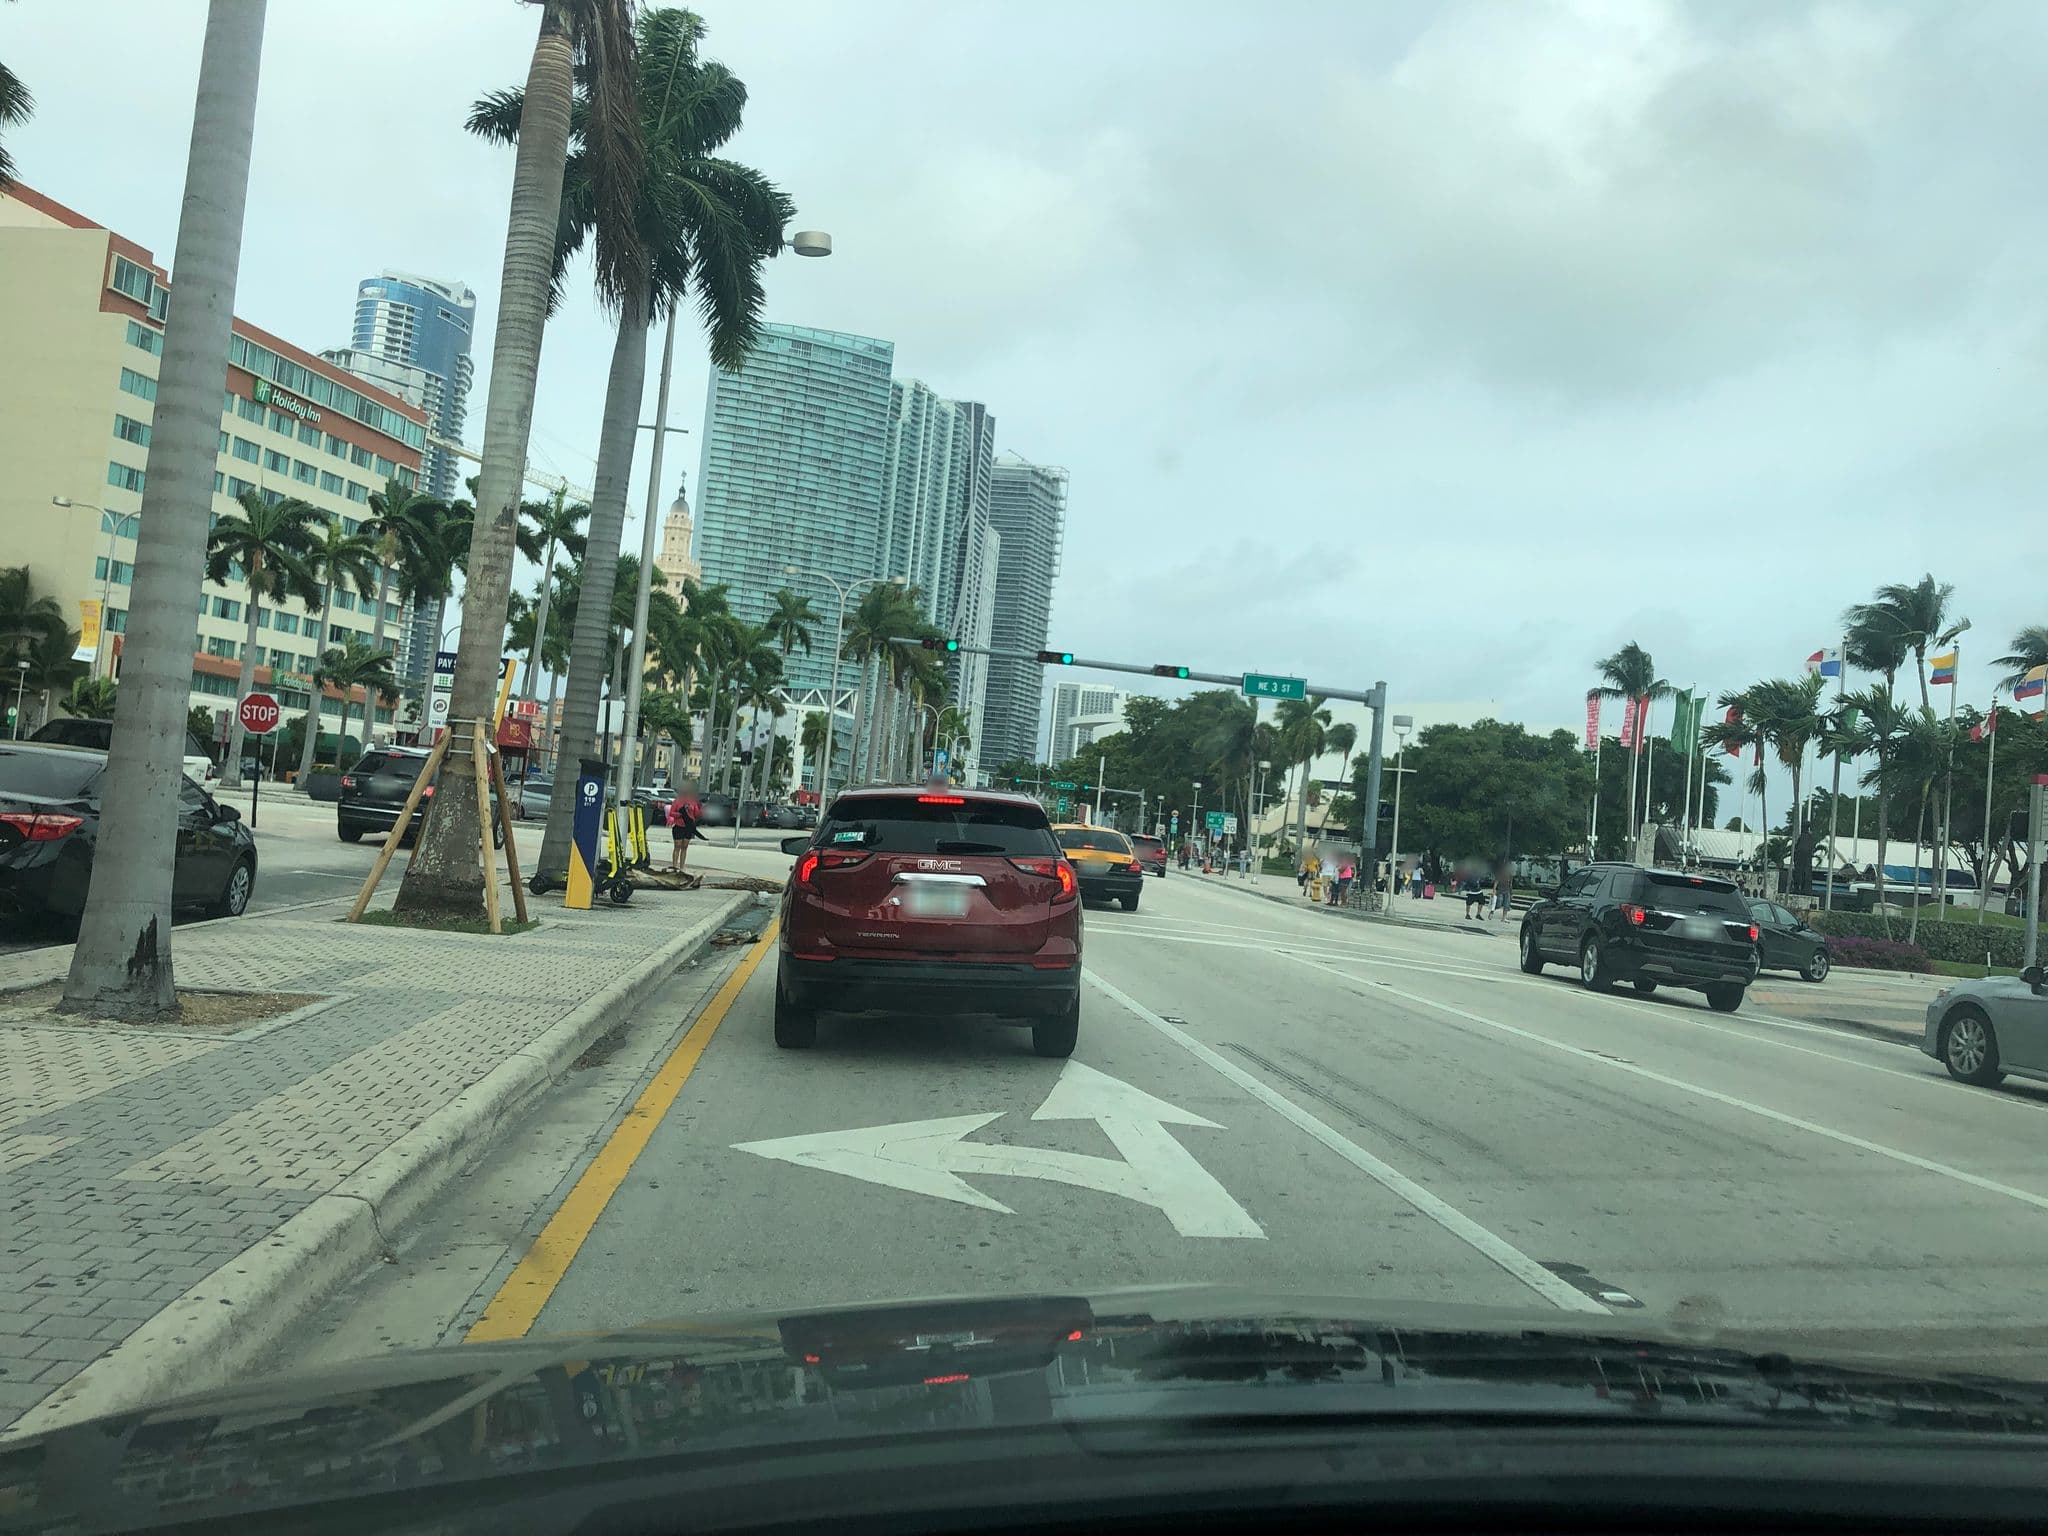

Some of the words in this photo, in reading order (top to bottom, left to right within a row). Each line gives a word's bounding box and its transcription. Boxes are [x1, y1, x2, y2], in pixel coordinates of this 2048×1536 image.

[271, 389, 307, 420] Holiday
[307, 404, 321, 423] Inn
[437, 657, 453, 669] PAY
[1257, 681, 1269, 691] NE
[1271, 681, 1278, 693] 3
[1281, 683, 1291, 693] ST
[241, 704, 278, 722] STOP
[1224, 825, 1236, 833] 30
[917, 859, 962, 871] GMC
